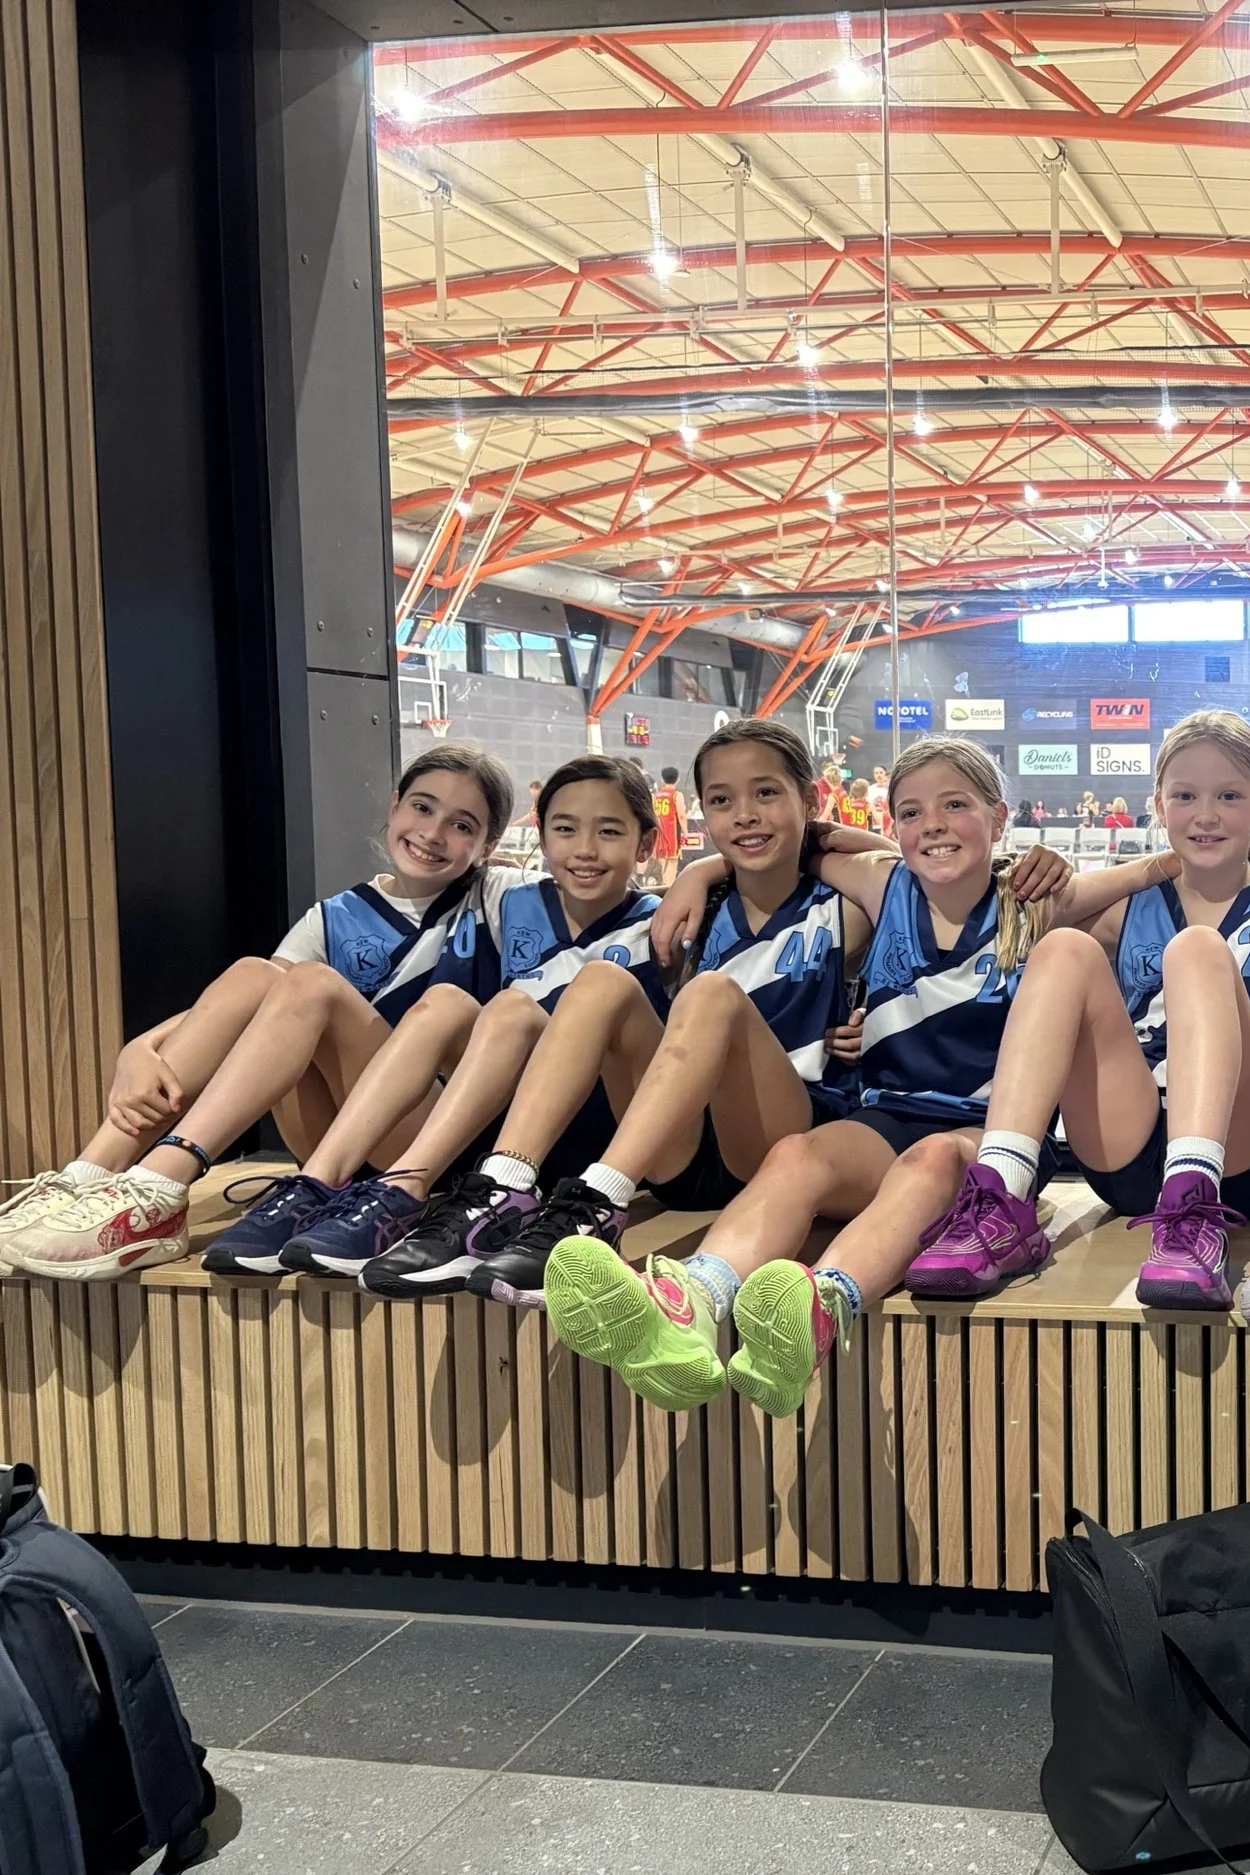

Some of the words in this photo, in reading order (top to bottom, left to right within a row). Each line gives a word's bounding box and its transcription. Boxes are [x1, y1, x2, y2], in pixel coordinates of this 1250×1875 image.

[878, 705, 929, 716] NOOTEL
[1036, 711, 1074, 719] RECYCLING
[1096, 760, 1146, 773] SIGNS.
[353, 948, 379, 972] K
[511, 938, 531, 960] K
[774, 926, 833, 983] 44
[1141, 953, 1162, 977] K
